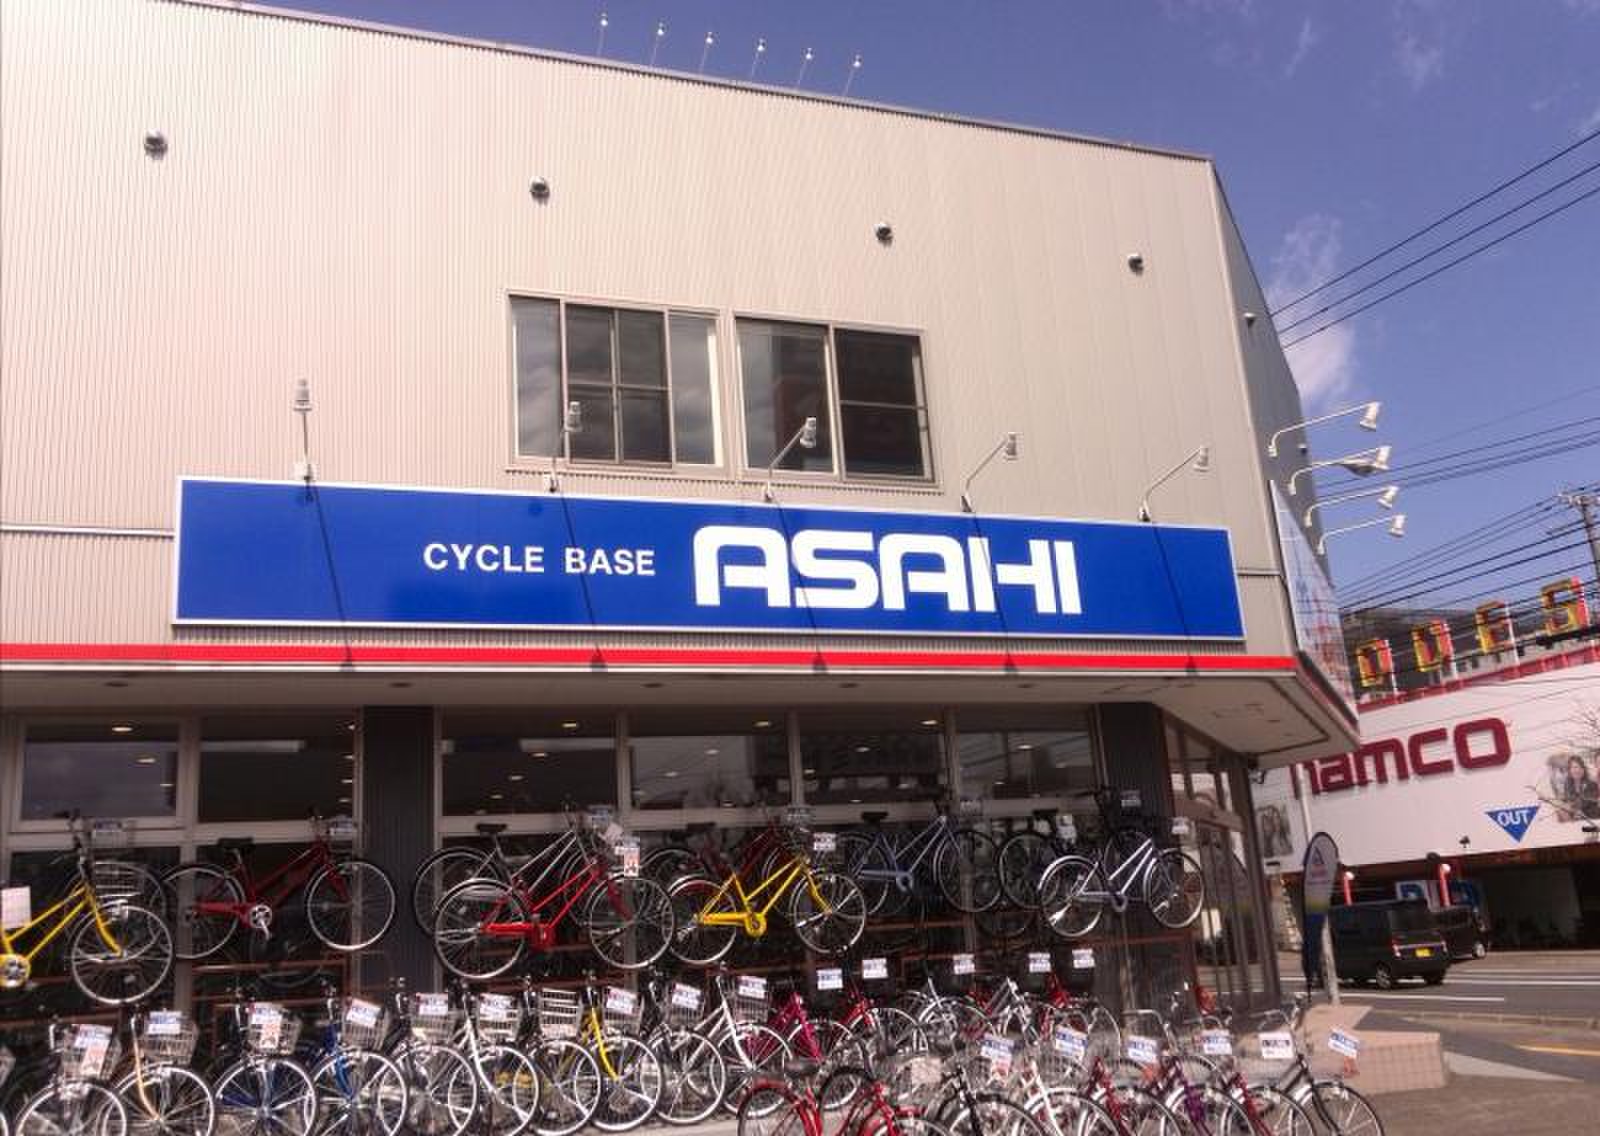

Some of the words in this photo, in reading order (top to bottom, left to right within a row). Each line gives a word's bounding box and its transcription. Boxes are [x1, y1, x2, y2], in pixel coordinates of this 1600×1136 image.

[423, 543, 545, 573] CYCLE
[565, 547, 656, 576] BASE
[693, 525, 1083, 614] ASAHI
[1496, 808, 1531, 827] OUT
